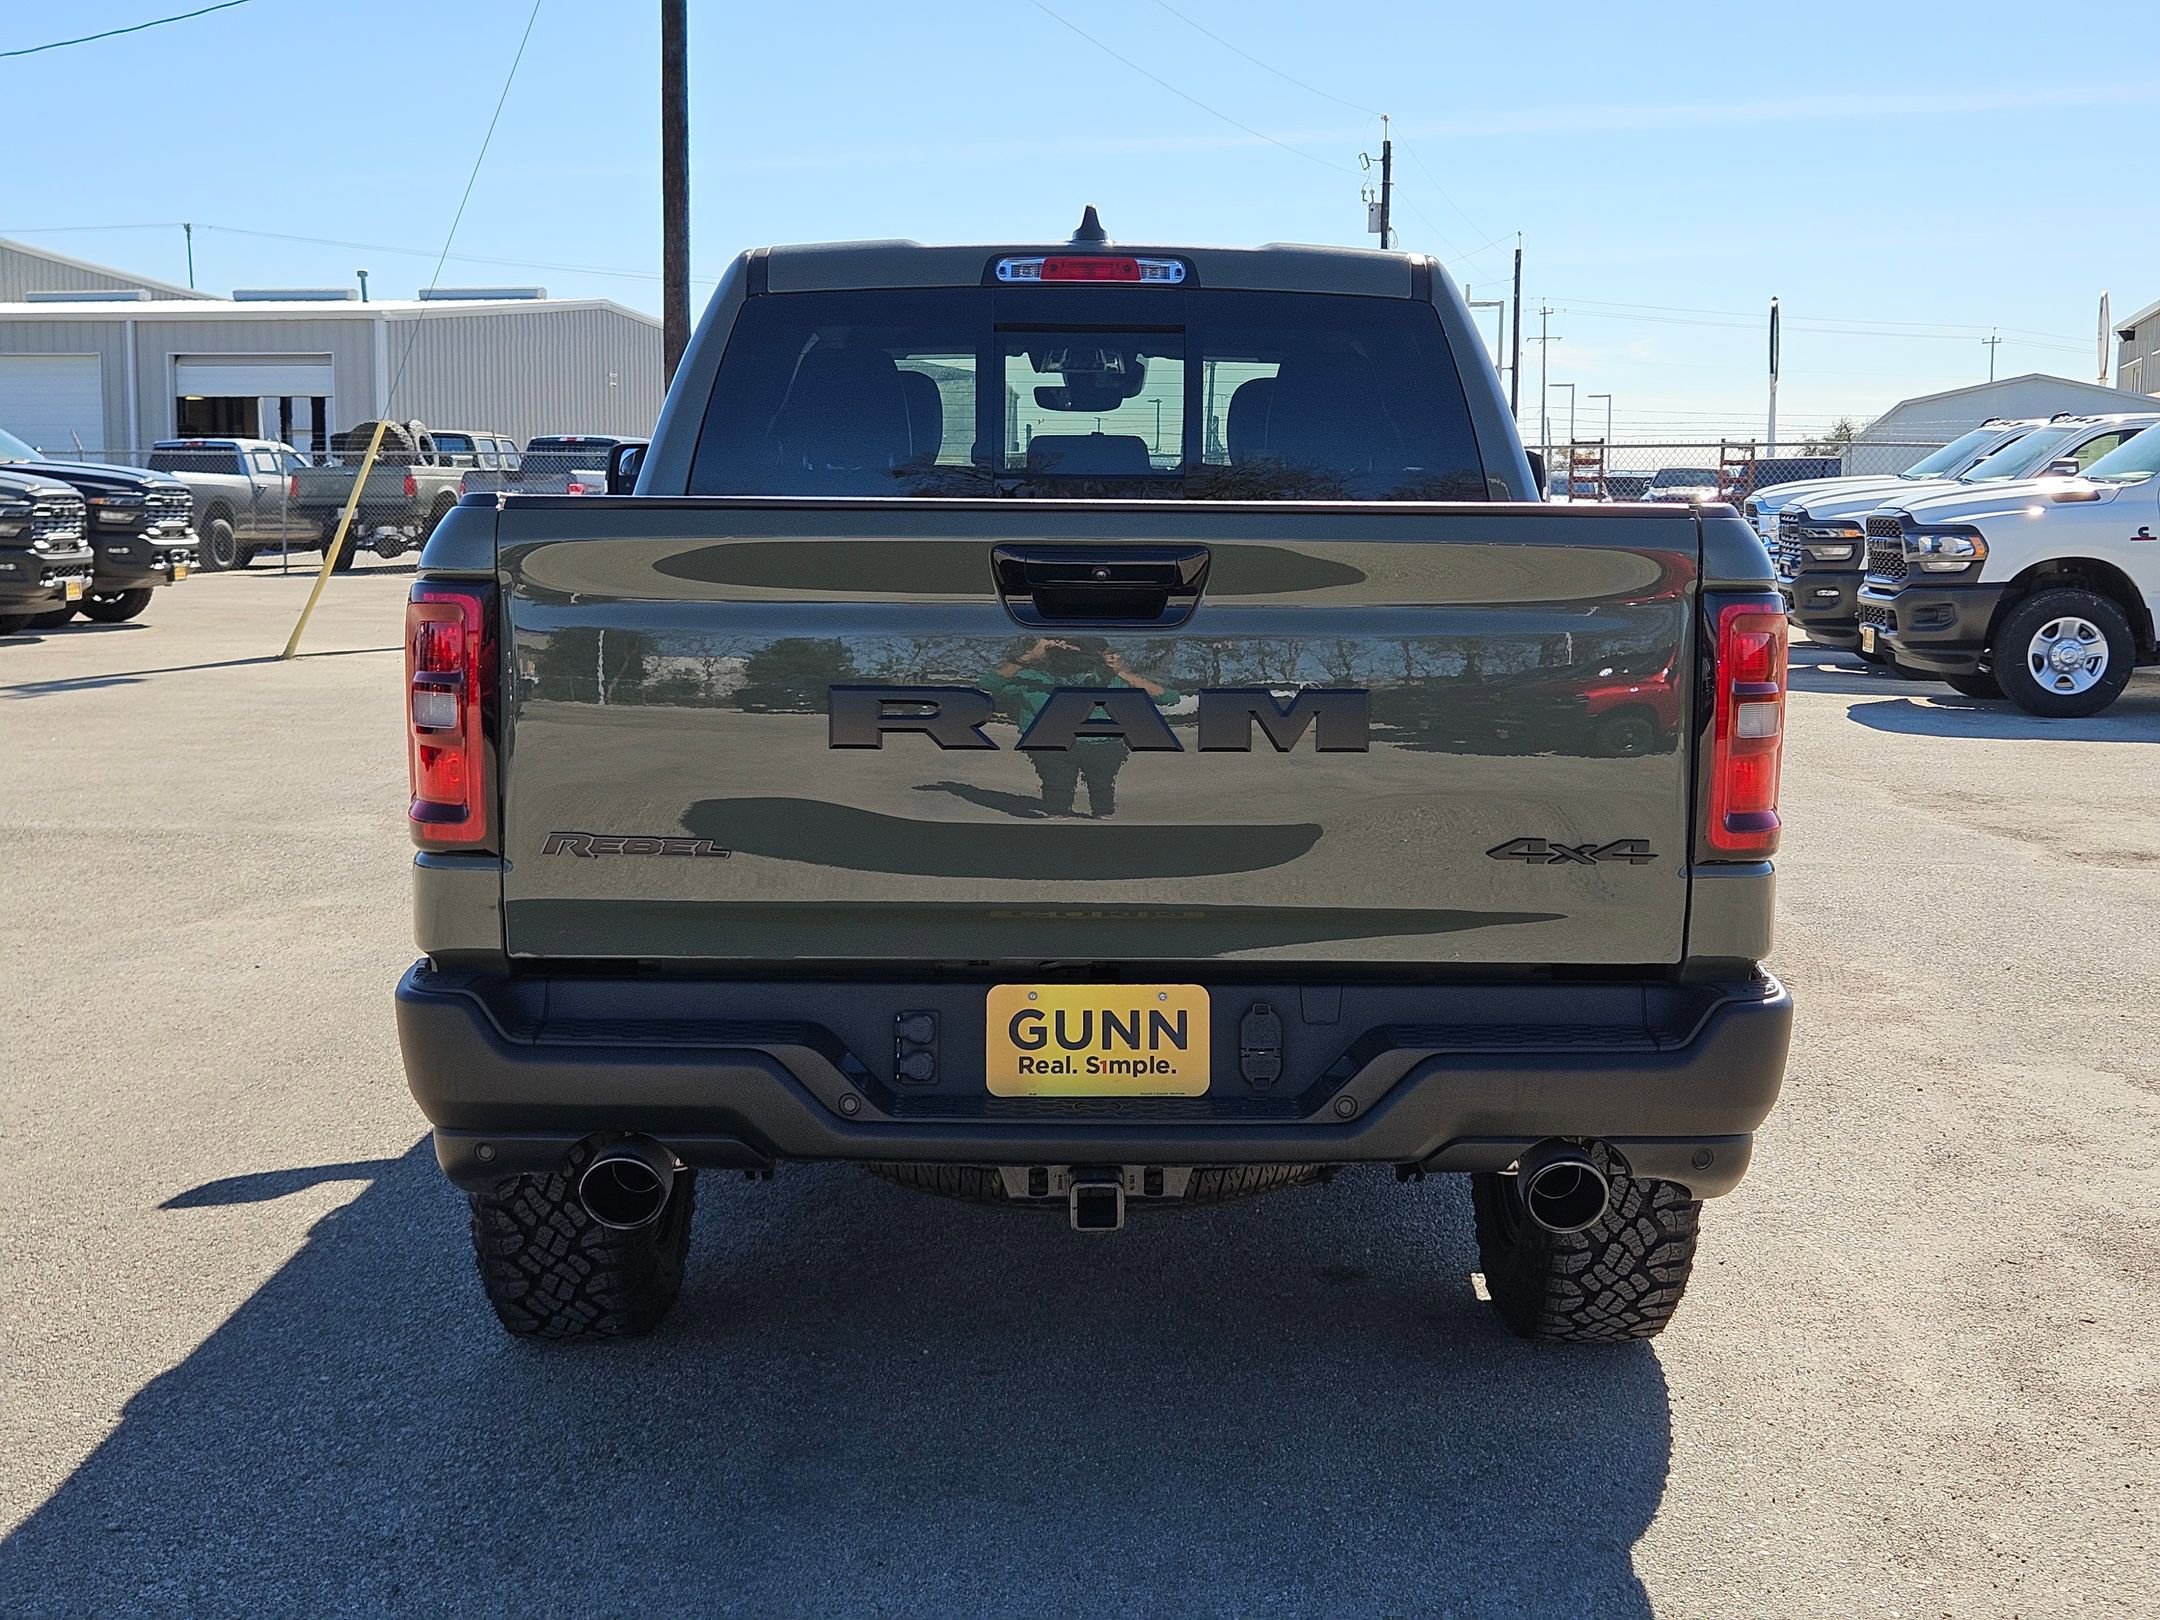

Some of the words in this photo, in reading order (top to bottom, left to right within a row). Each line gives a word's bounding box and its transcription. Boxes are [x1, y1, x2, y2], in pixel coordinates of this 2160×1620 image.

[828, 685, 1370, 753] RAM
[540, 831, 732, 860] REBEL
[1485, 837, 1660, 865] 4x4
[1008, 1008, 1188, 1051] GUNN
[1018, 1055, 1078, 1075] Real.
